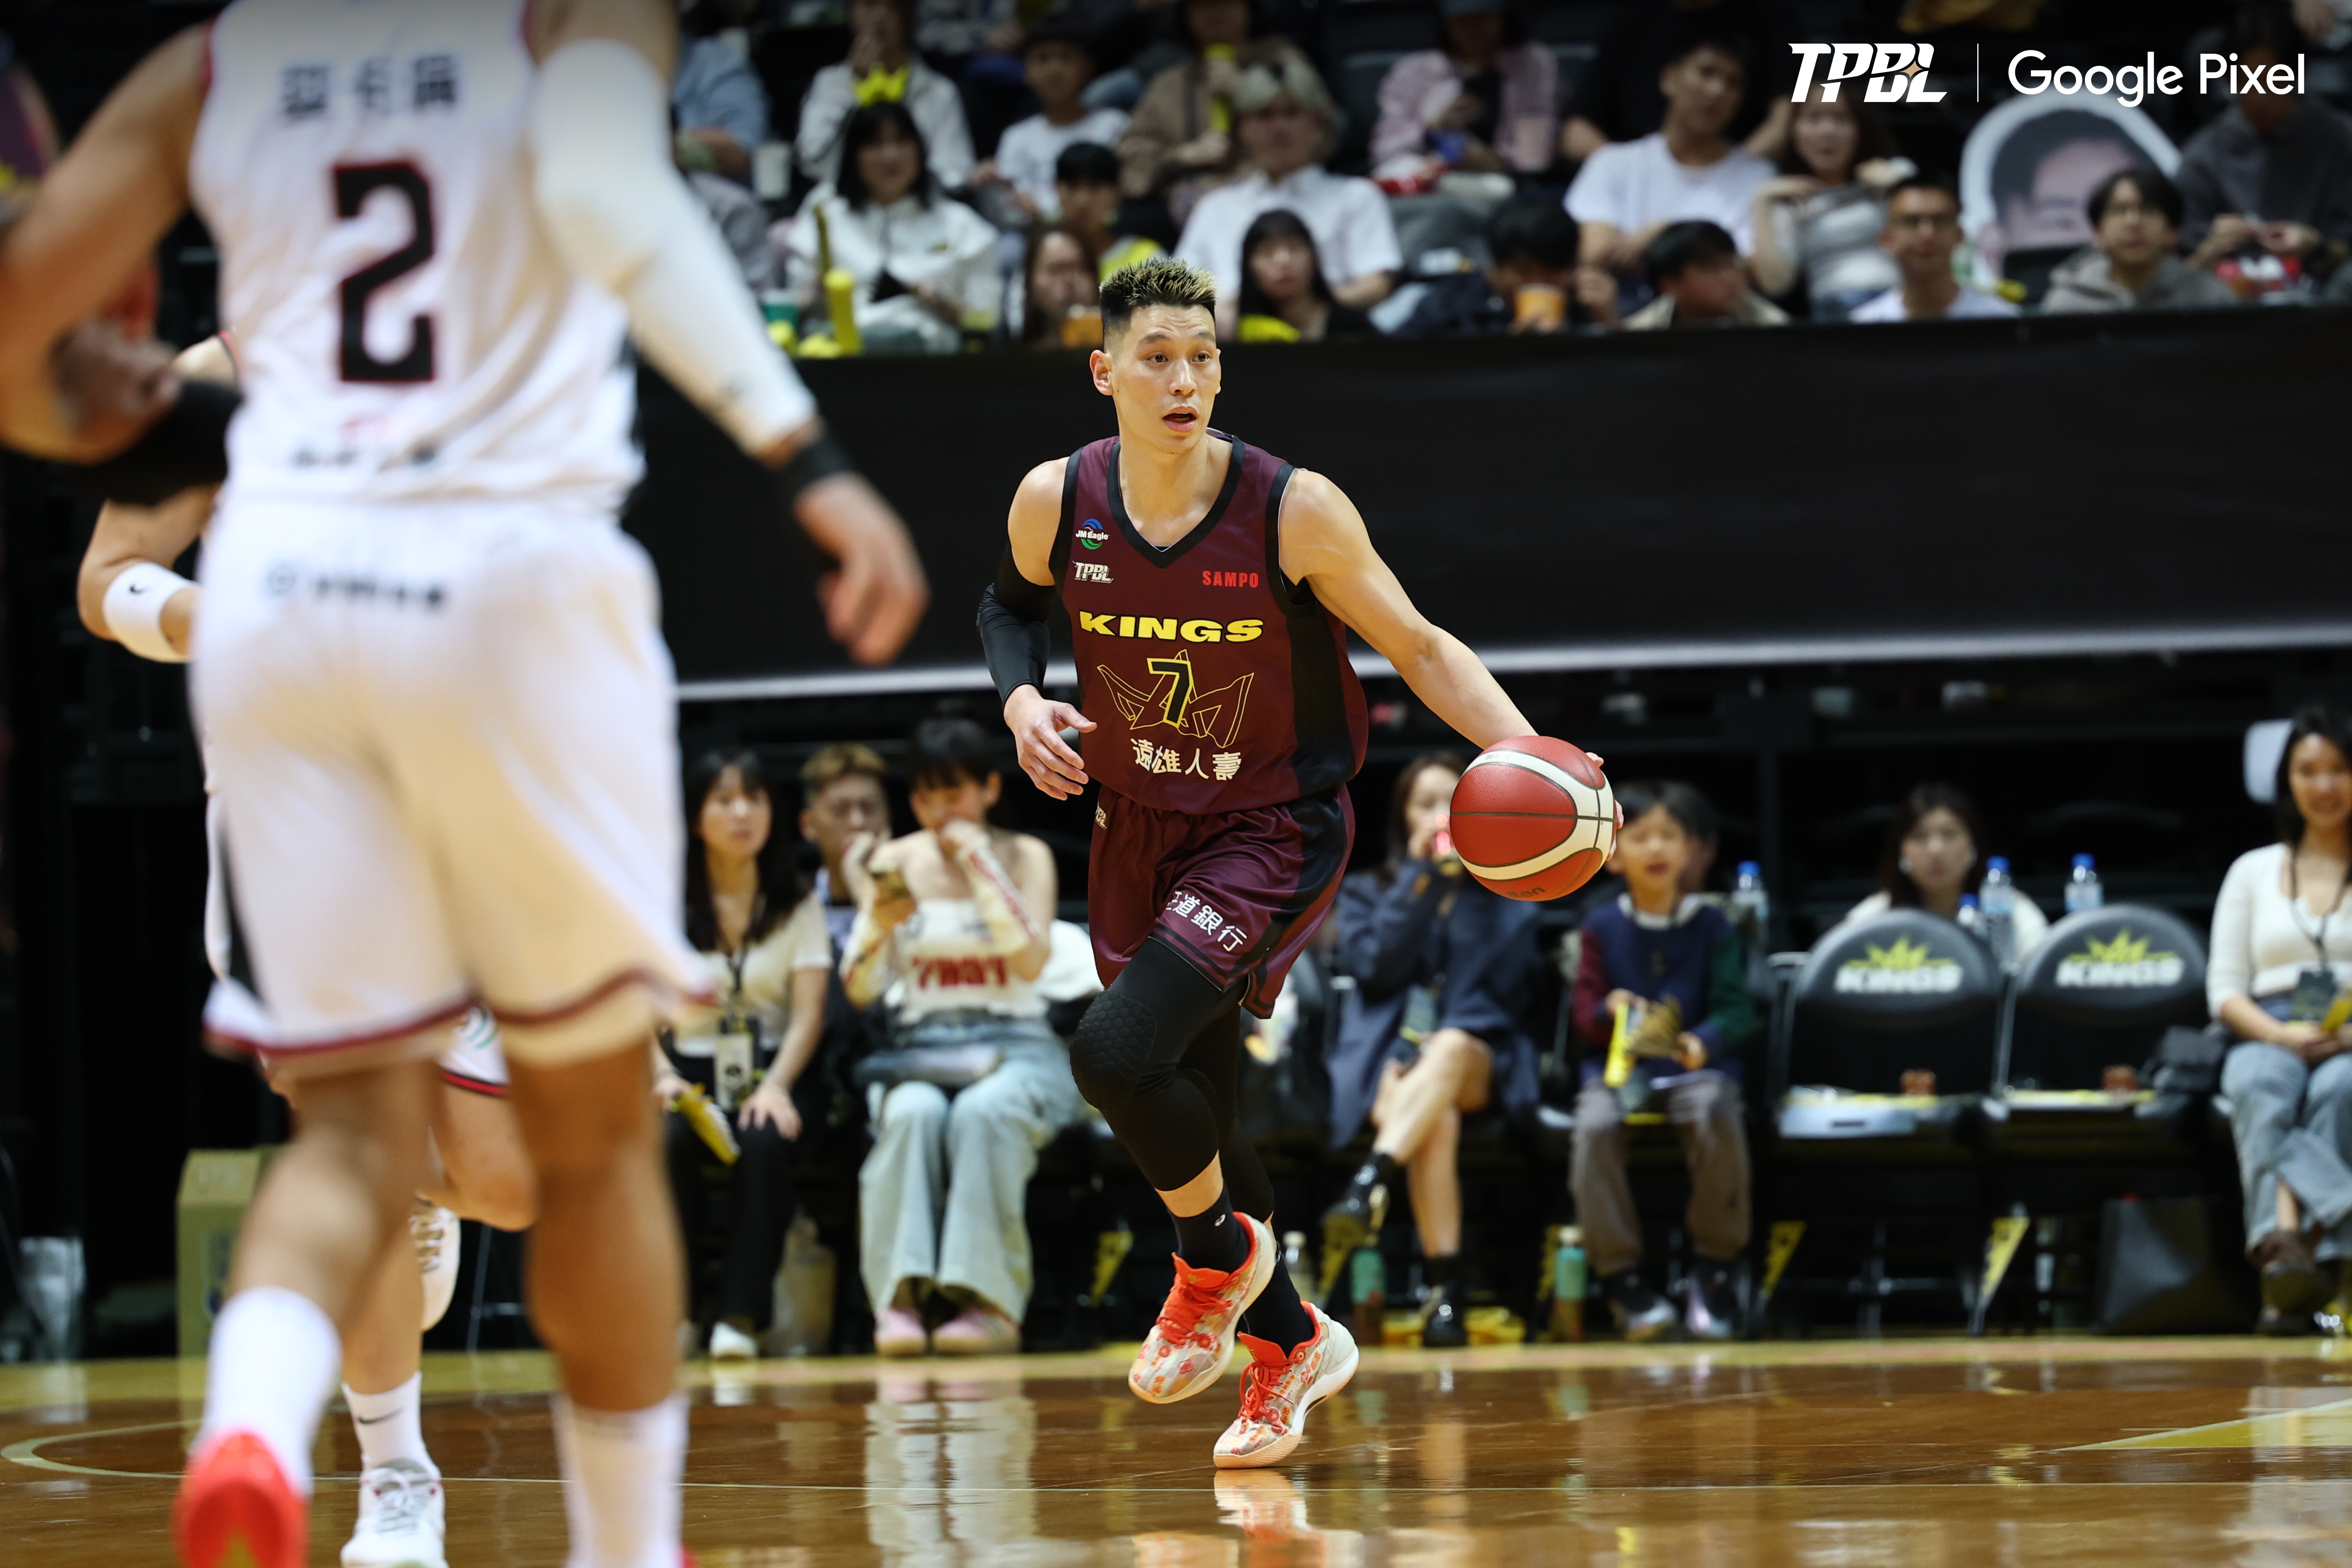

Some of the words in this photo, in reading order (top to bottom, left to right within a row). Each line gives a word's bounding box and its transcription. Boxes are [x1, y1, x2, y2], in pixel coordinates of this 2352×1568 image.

[332, 162, 435, 382] 2
[1087, 532, 1109, 541] Eagle
[1073, 561, 1113, 583] TPBL
[1202, 570, 1259, 588] SAMPO
[1079, 610, 1264, 643] KINGS
[1147, 657, 1193, 728] 7
[1130, 738, 1242, 781] 遠雄人壽
